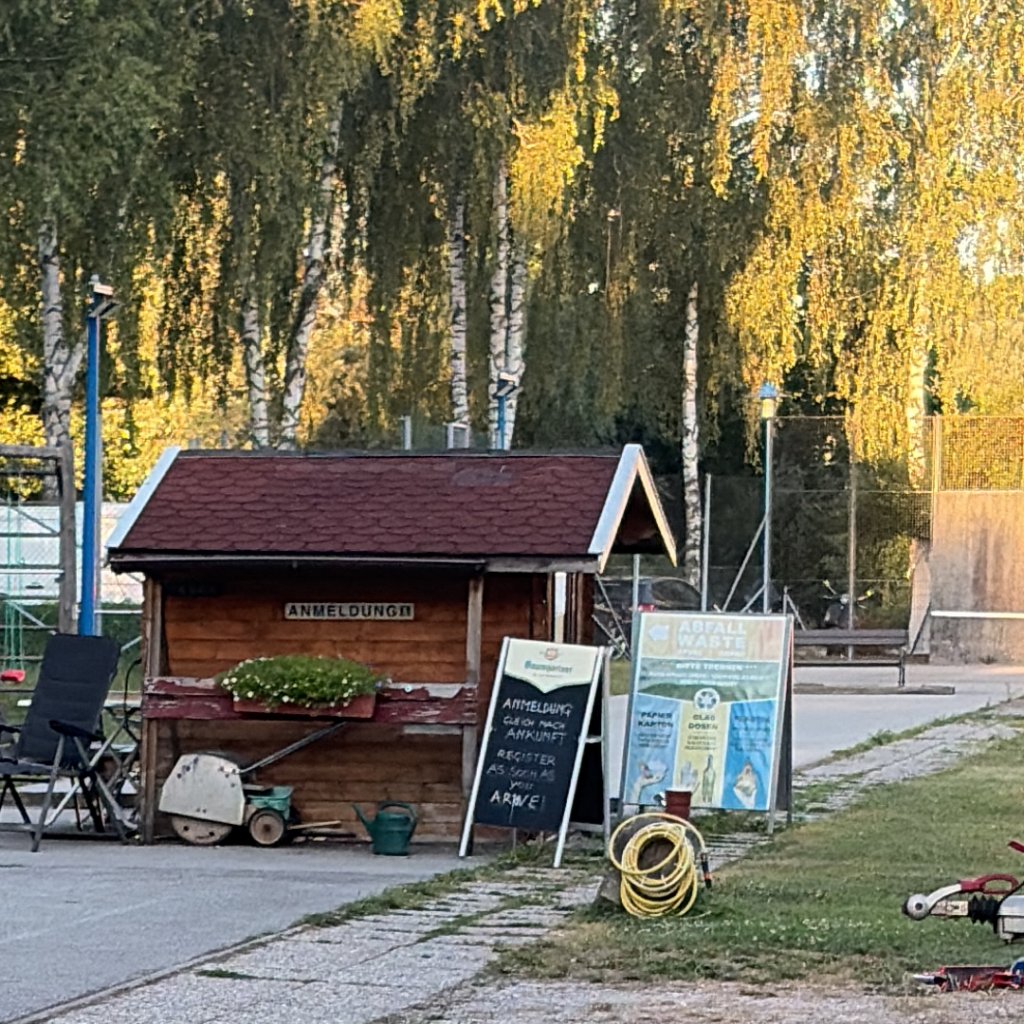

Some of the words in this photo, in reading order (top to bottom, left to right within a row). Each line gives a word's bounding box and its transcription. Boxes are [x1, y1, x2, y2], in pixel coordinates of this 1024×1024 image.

[678, 619, 746, 634] ABFALL
[678, 634, 745, 649] WASTE
[502, 698, 573, 717] ANMELDUNG
[505, 728, 566, 745] ANKUNFT
[497, 749, 556, 766] REGISTER
[486, 763, 505, 776] AS
